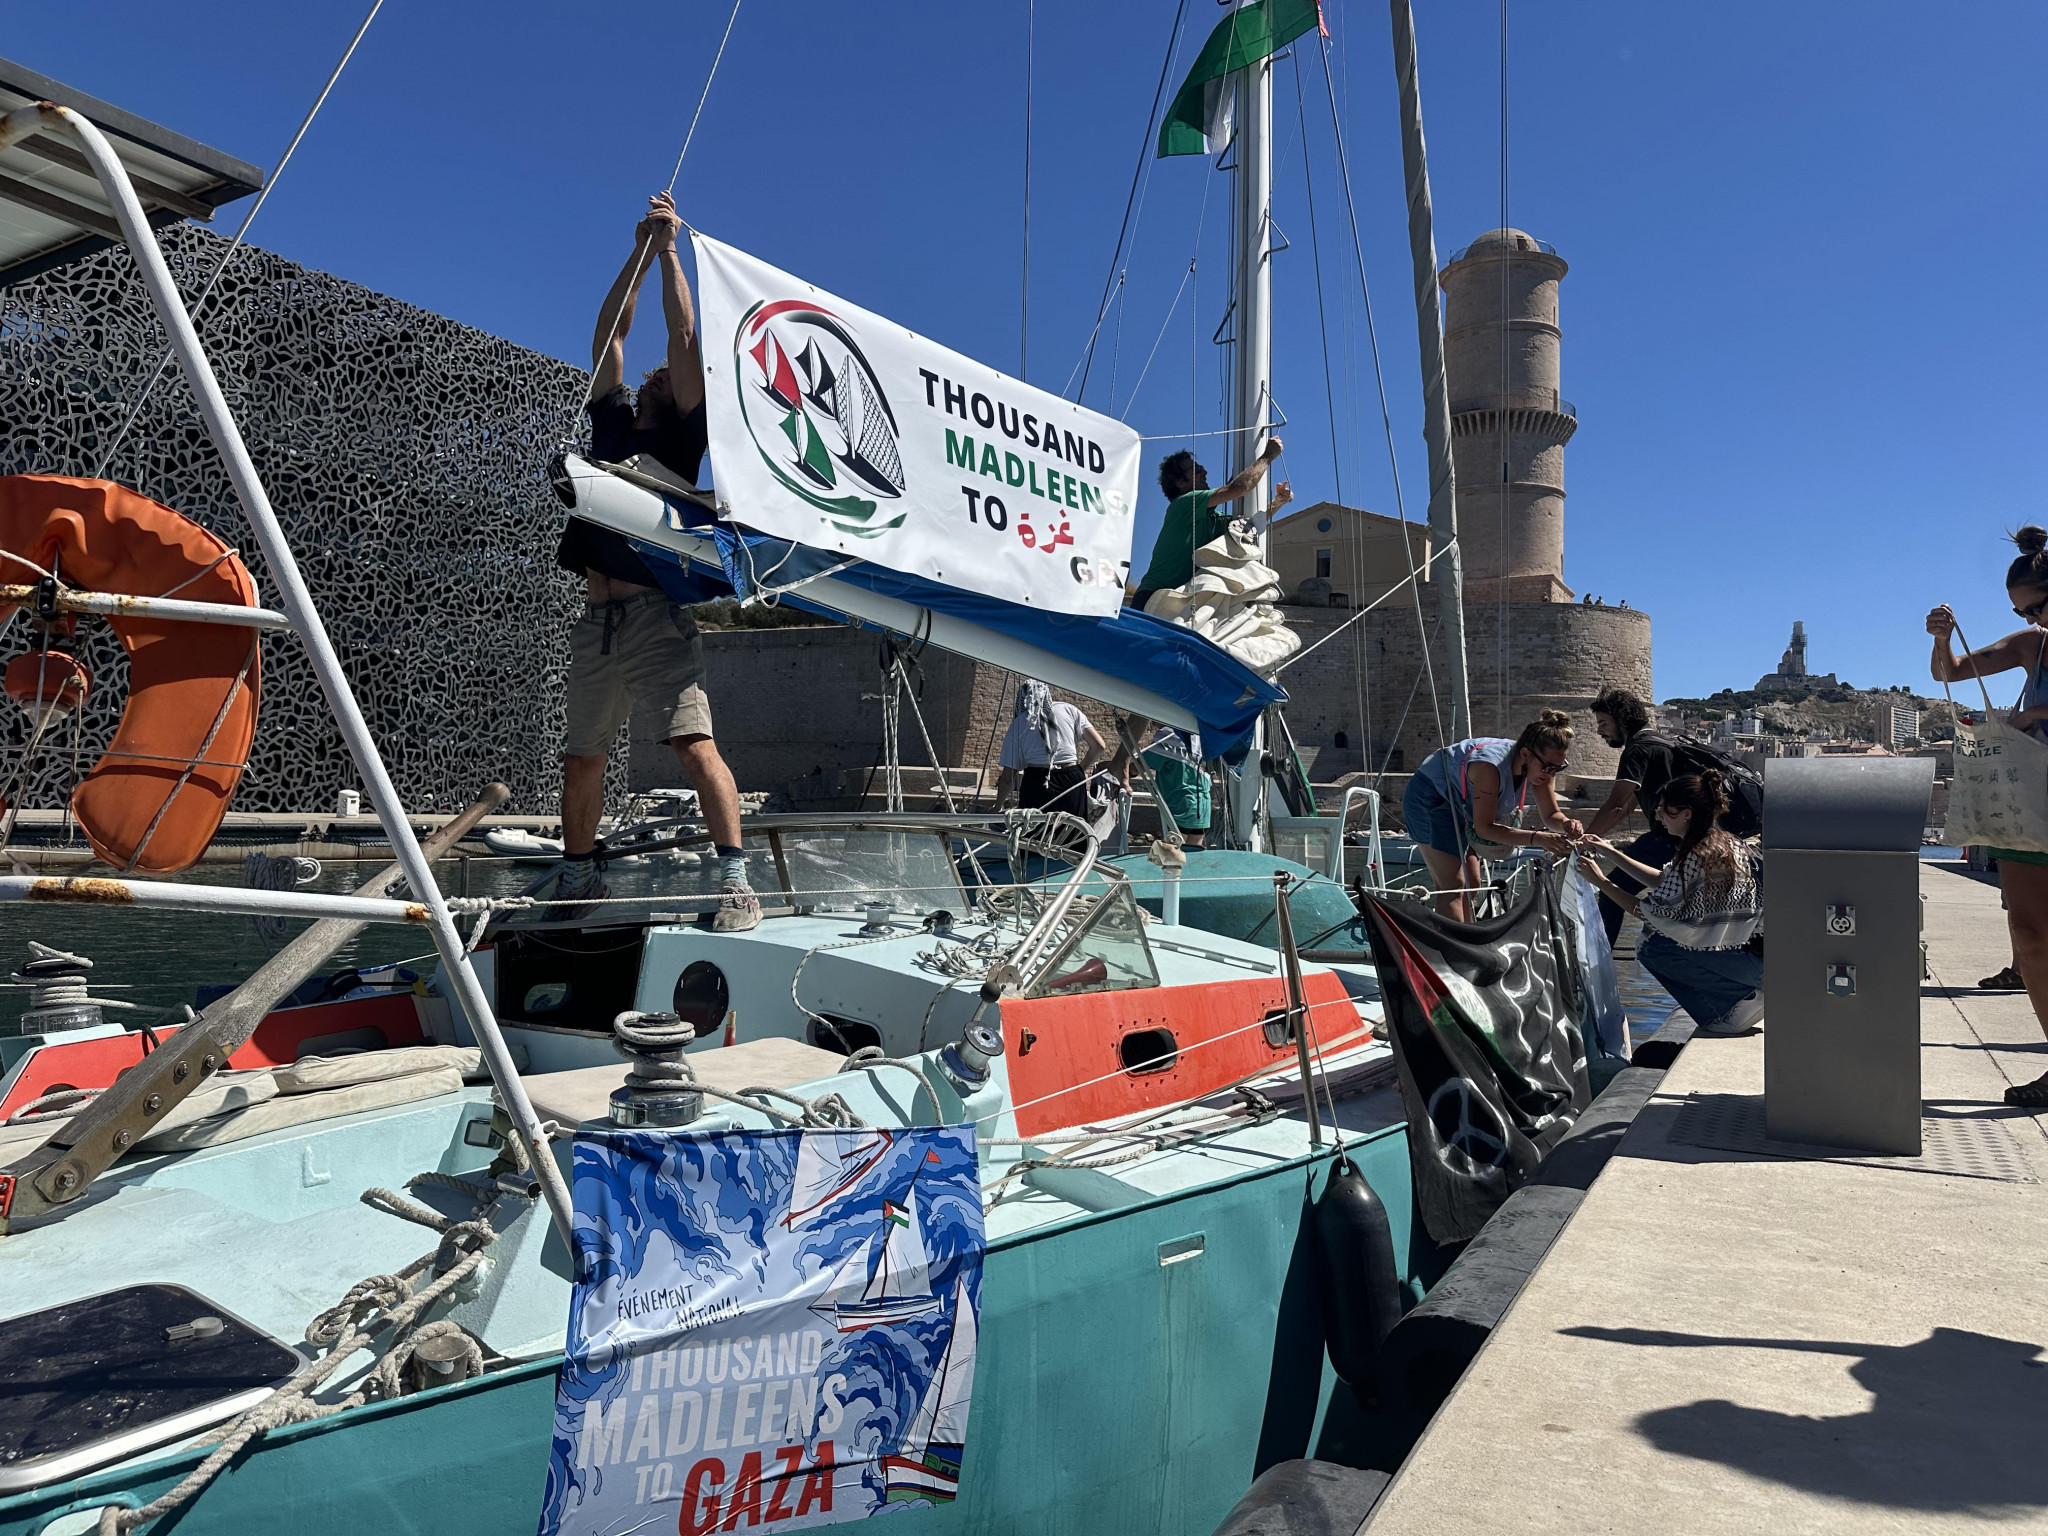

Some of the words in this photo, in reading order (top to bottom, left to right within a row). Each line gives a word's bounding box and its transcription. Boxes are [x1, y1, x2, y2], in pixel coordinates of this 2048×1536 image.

[919, 367, 1105, 474] THOUSAND
[945, 428, 1129, 517] MADLEENS
[961, 485, 1008, 532] TO
[1017, 509, 1074, 554] غزة
[1956, 746, 2003, 758] BLAIZE
[631, 1330, 822, 1392] THOUSAND
[577, 1373, 848, 1470] MADLEENS
[635, 1462, 674, 1504] TO
[678, 1439, 835, 1536] GAZA
